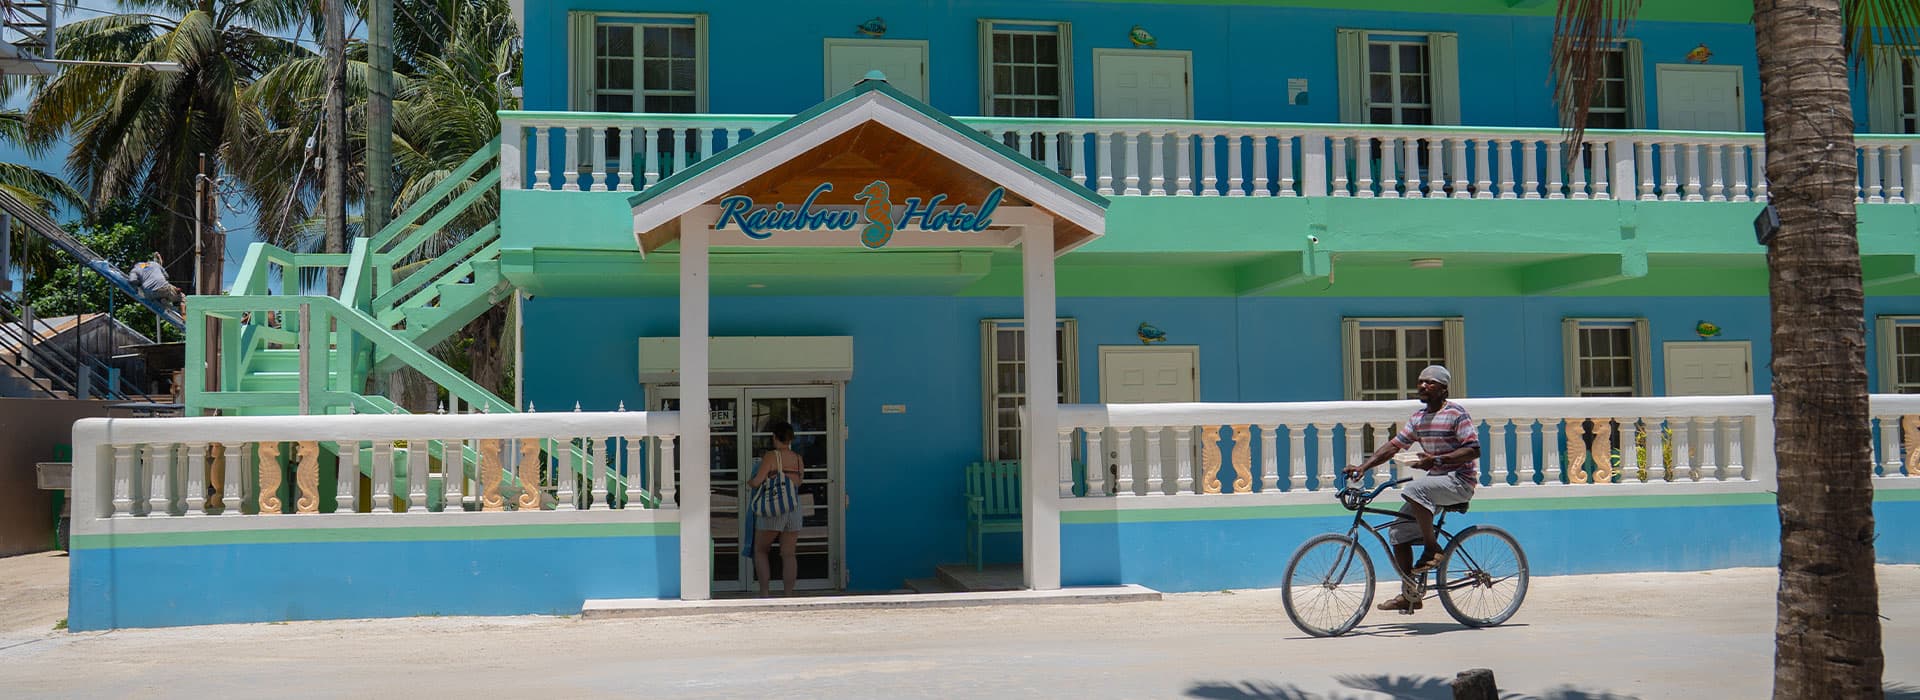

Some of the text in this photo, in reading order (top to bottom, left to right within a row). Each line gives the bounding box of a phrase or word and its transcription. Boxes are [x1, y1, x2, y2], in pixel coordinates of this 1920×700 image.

[715, 182, 1005, 239] Rainbow Hotel
[711, 411, 729, 420] PEN
